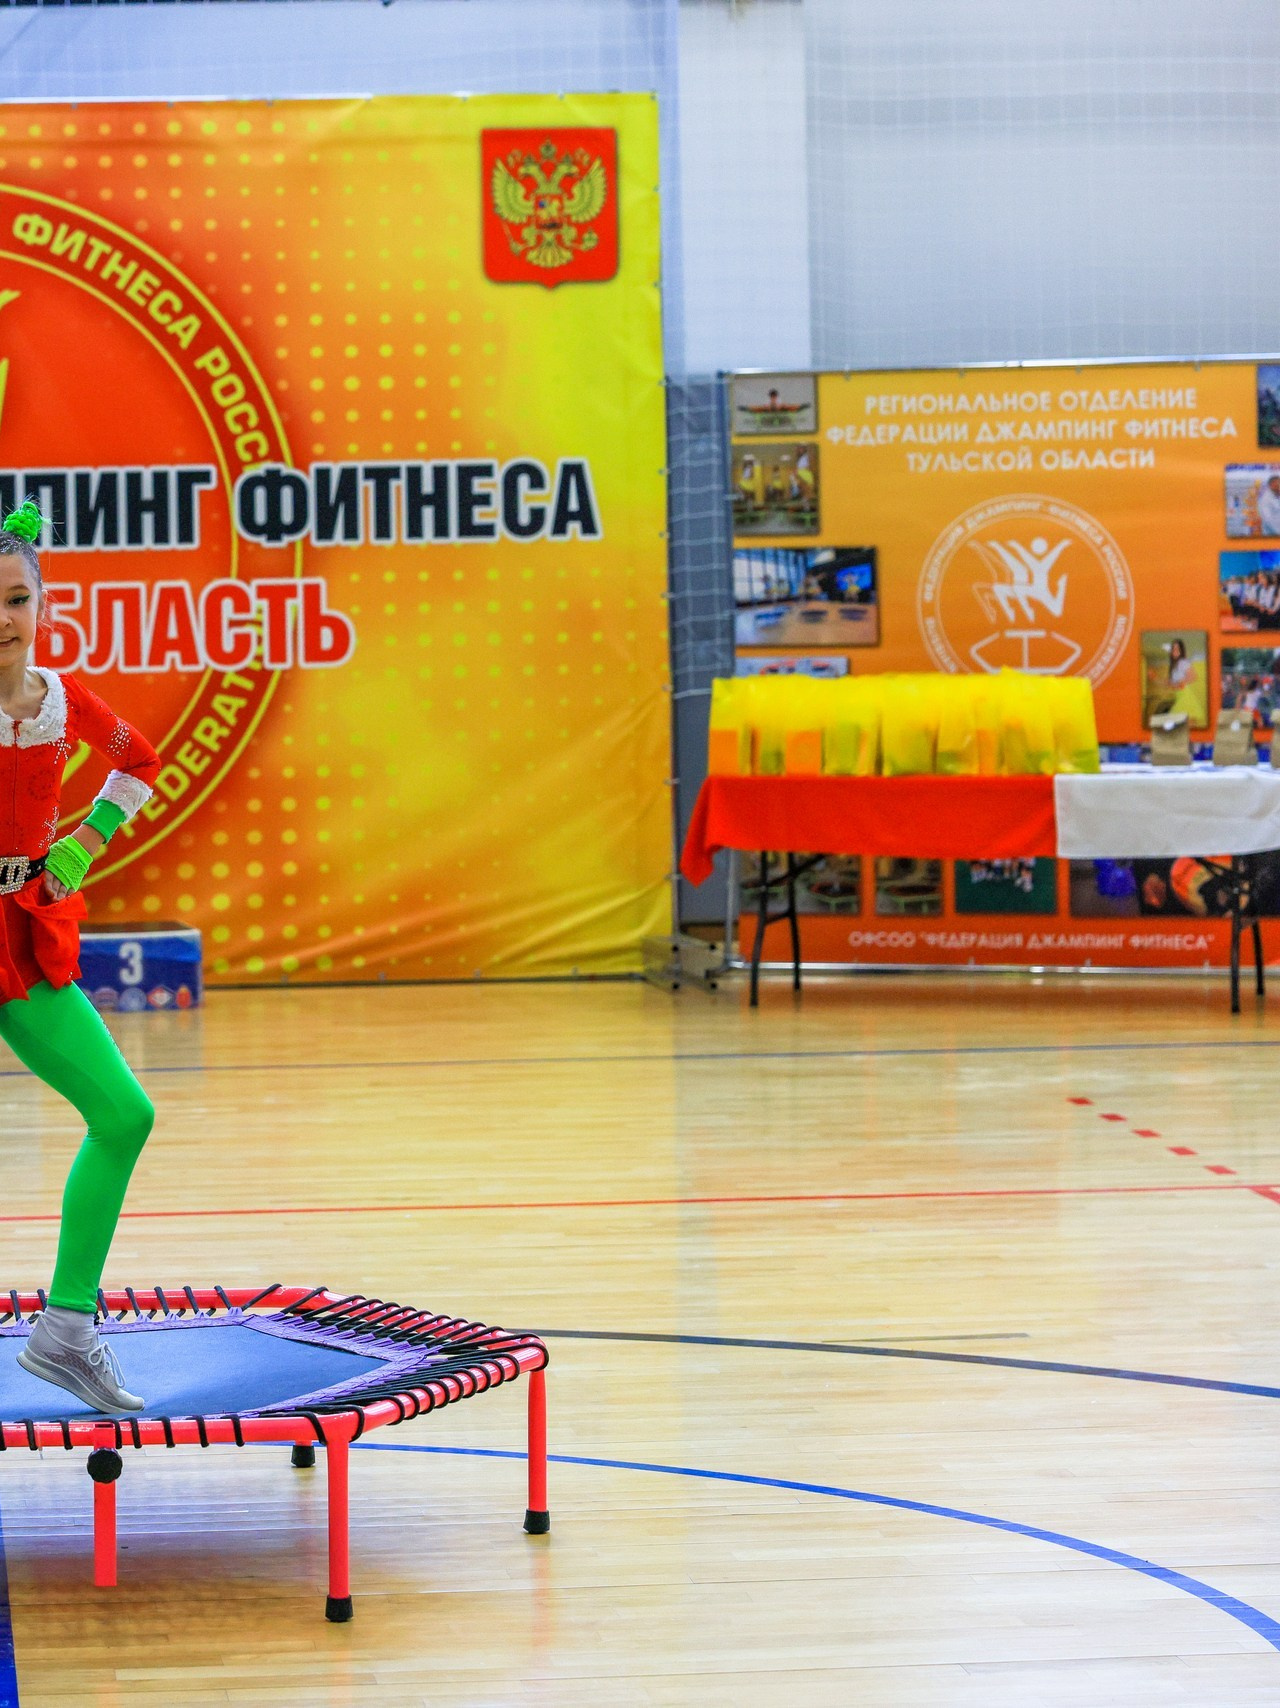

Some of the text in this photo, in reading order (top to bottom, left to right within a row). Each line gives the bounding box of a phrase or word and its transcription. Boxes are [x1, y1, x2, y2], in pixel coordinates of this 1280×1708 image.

[12, 213, 202, 350] ФИТНЕСА
[194, 346, 271, 471] РОСС
[864, 388, 1197, 416] РЕГИОНАЛЬНОЕ ОТДЕЛЕНИЕ
[826, 417, 1238, 446] ФЕДЕРАЦИИ ДЖАМПИНГ ФИТНЕСА
[906, 445, 1155, 474] ТУЛЬСКОЙ ОБЛАСТИ
[233, 457, 604, 548] ФИТНЕСА
[121, 630, 268, 838] EDERAT
[119, 942, 143, 986] 3
